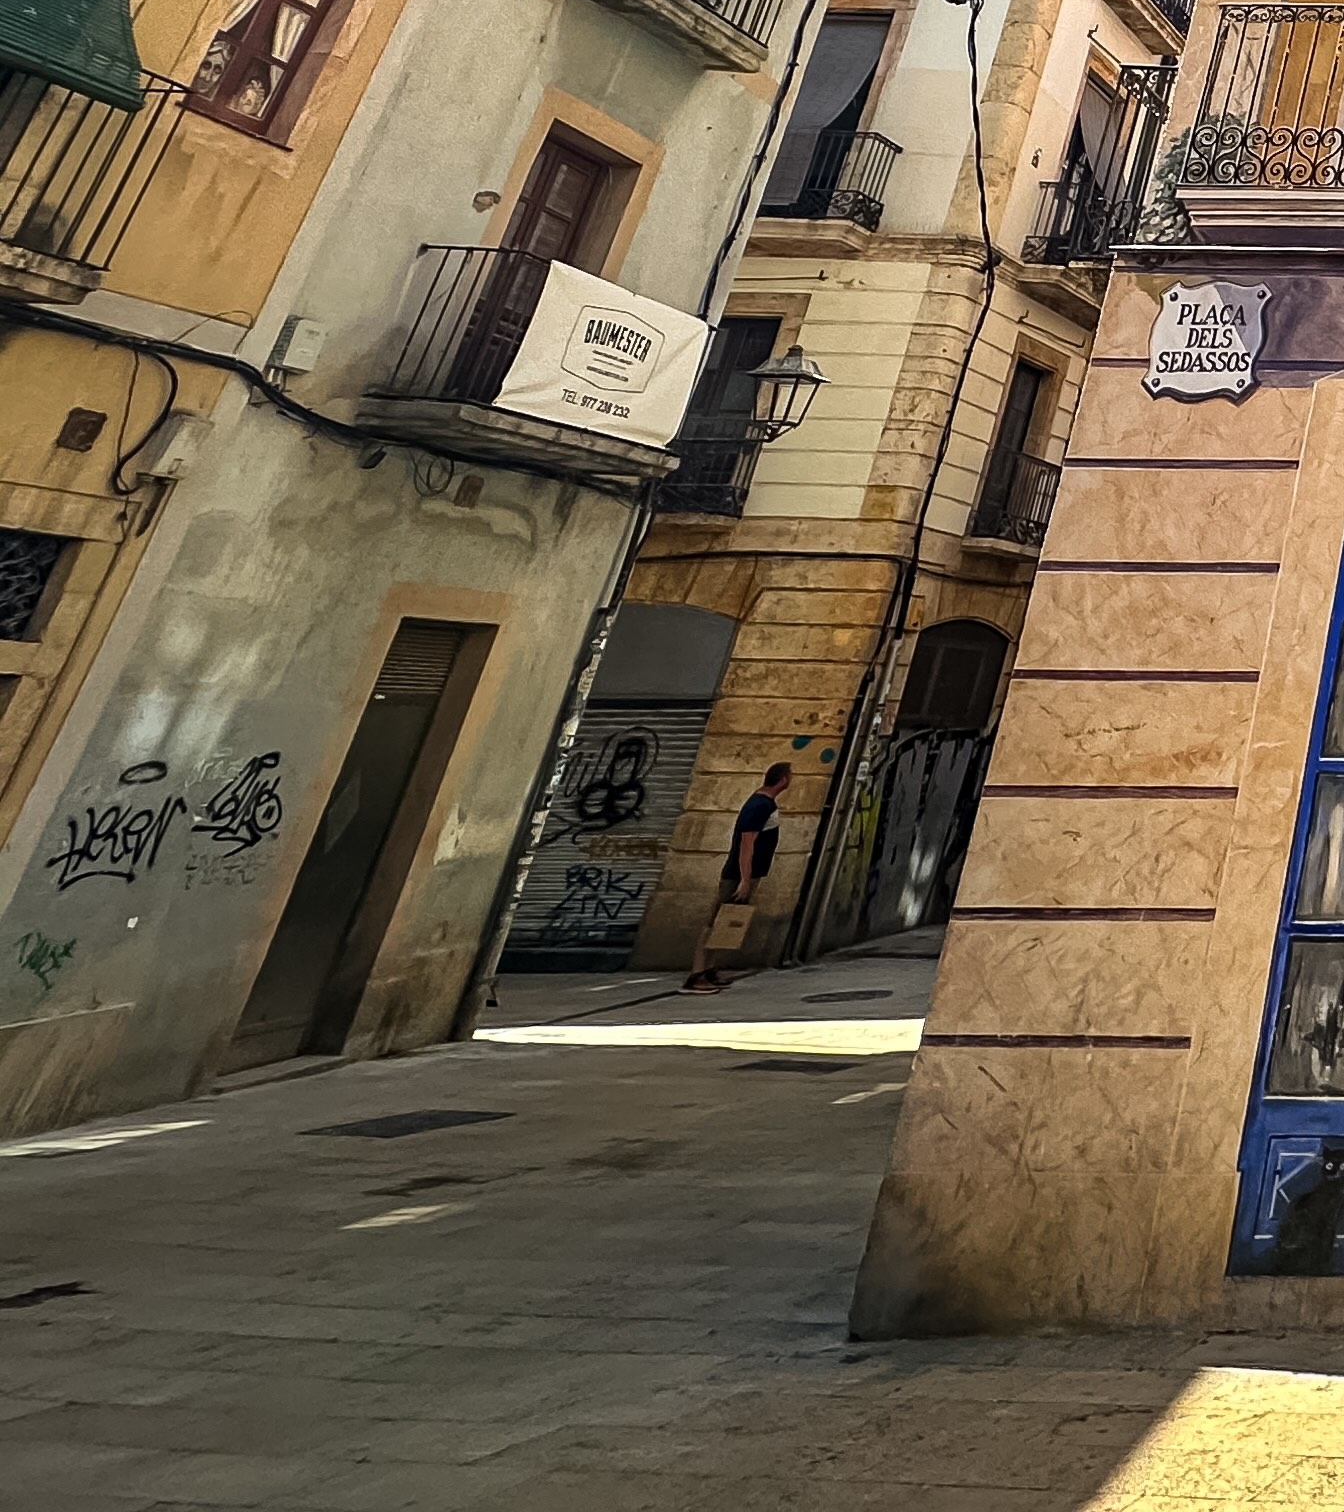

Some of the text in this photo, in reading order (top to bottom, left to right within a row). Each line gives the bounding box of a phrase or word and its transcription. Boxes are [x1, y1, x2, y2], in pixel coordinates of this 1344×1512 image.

[1177, 303, 1247, 327] PLAÇA
[584, 319, 652, 363] BAUMESTER
[1185, 327, 1233, 349] DELS
[1156, 351, 1252, 373] SEDASSOS
[580, 394, 598, 409] 977
